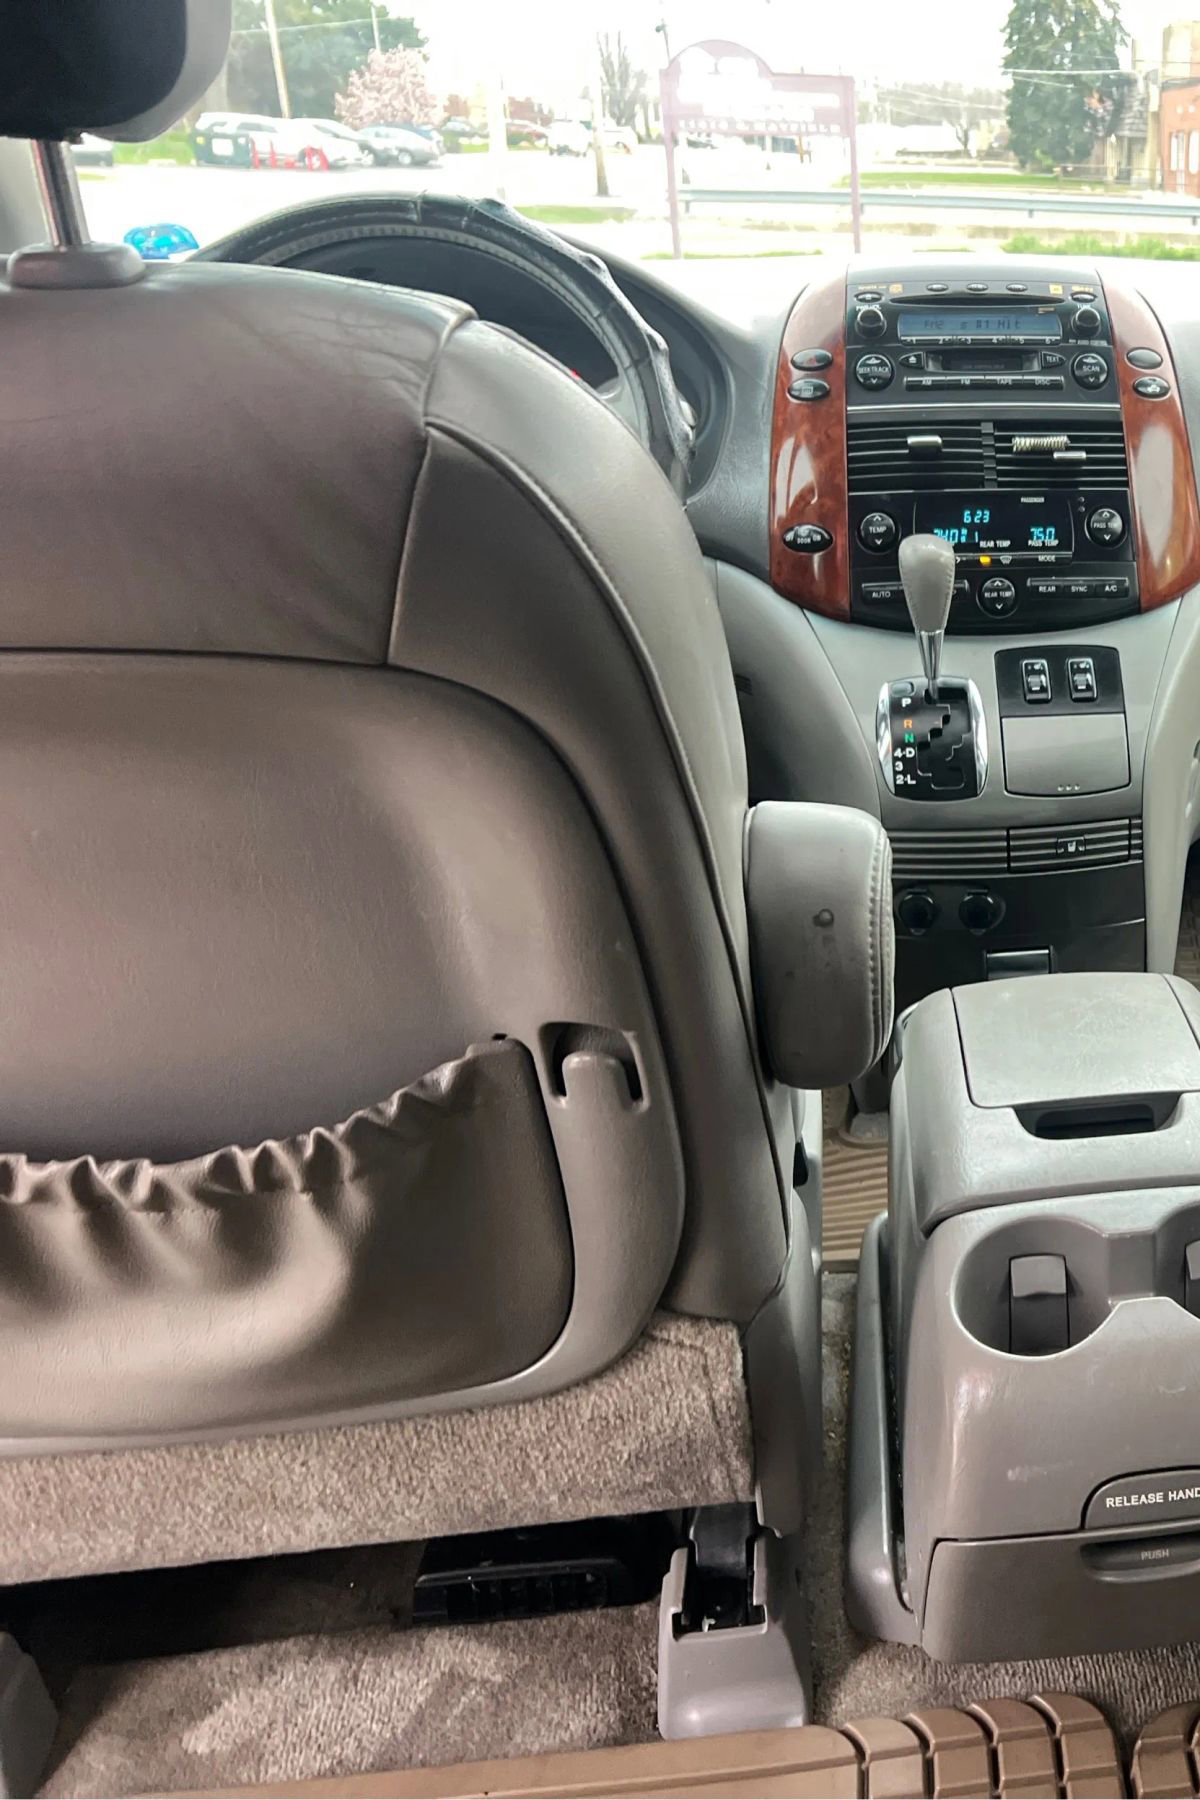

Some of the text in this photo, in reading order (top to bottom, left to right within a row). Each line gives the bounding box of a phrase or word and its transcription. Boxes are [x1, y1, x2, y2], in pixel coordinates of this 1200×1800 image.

[1046, 355, 1060, 363] TEXT
[1082, 365, 1100, 373] SCAN
[868, 526, 888, 534] TEMP
[1071, 585, 1088, 593] SYNC
[1105, 583, 1118, 592] A/C
[901, 697, 912, 708] P
[903, 719, 913, 729] R
[904, 732, 914, 743] N
[894, 761, 904, 771] 3
[1106, 1492, 1164, 1508] RELEASE
[1141, 1549, 1170, 1560] PUSH
